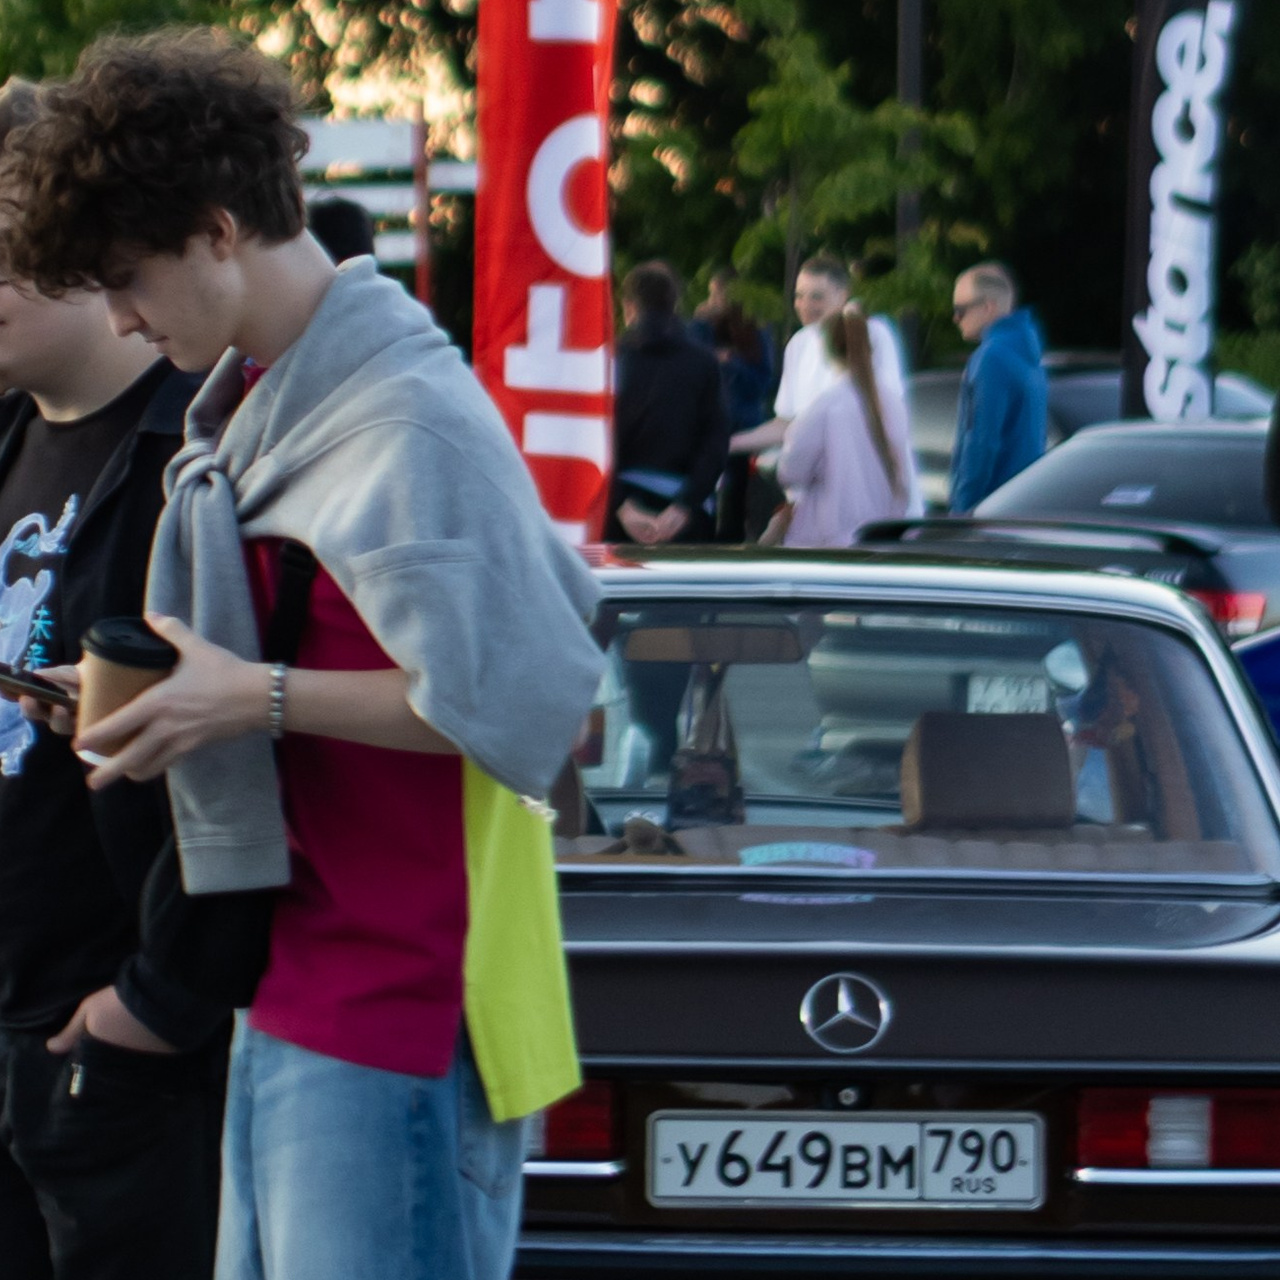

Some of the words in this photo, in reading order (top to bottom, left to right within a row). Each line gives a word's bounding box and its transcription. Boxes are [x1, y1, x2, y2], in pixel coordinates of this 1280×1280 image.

[23, 604, 55, 671] 未来
[677, 1129, 916, 1190] У649ВМ
[926, 1128, 1018, 1174] 790
[950, 1176, 998, 1194] RUS
